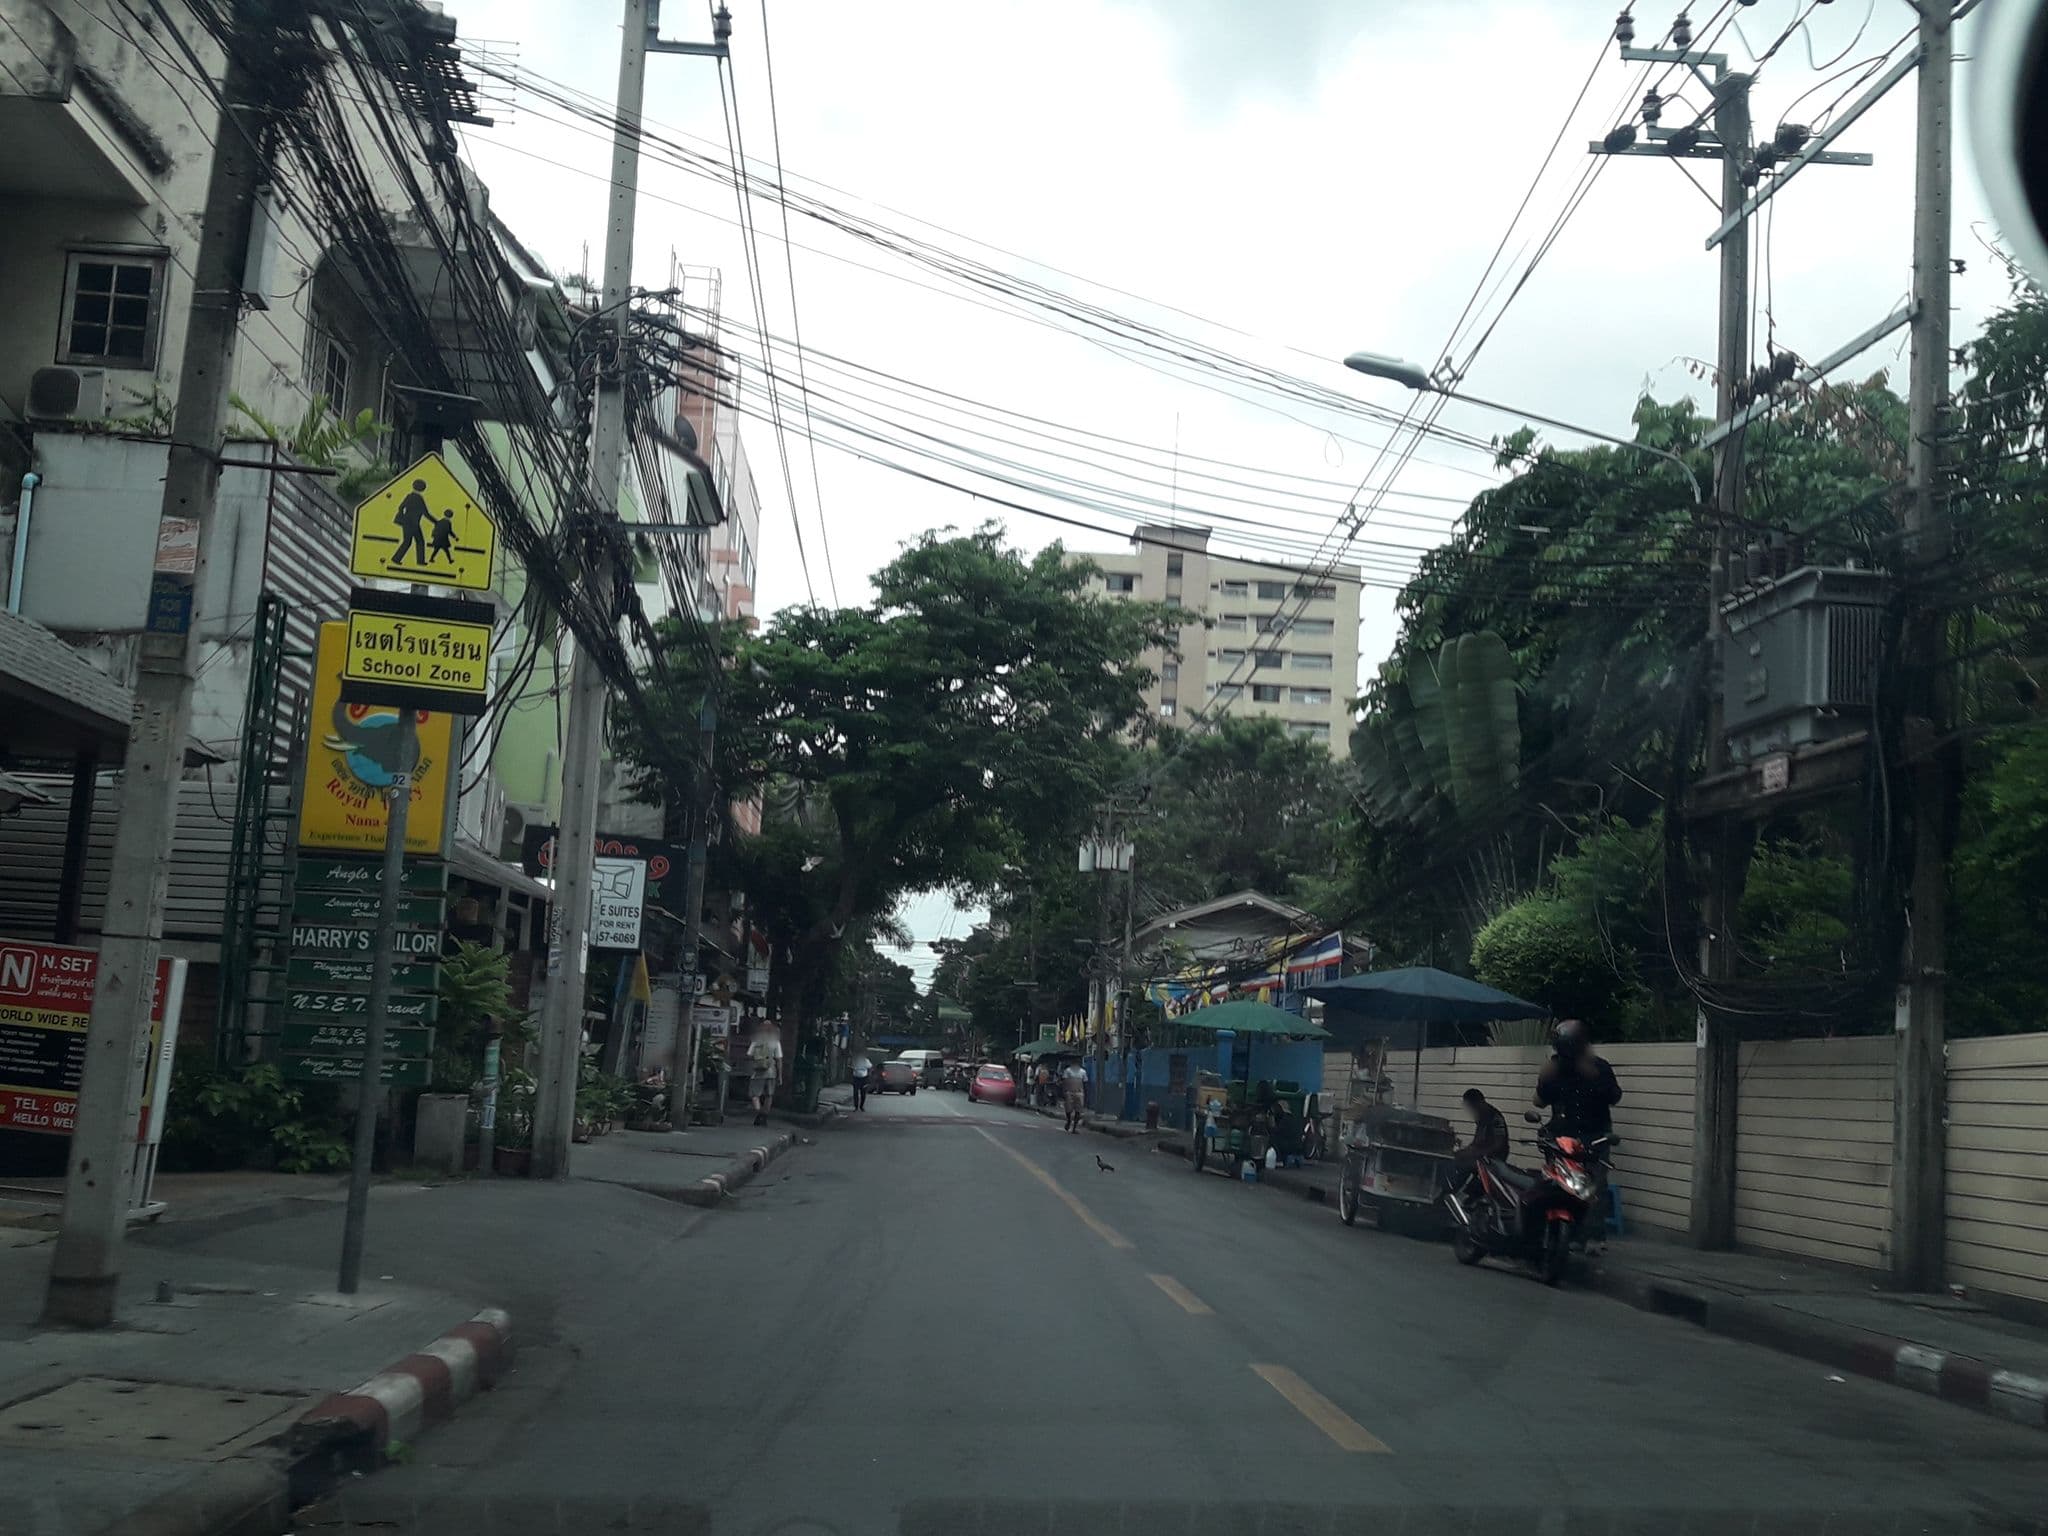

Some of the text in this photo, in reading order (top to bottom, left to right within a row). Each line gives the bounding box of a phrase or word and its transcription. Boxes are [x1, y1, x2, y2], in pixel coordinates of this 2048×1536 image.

[355, 623, 481, 661] เขตโรงเรียน
[362, 657, 471, 683] School Zone
[327, 778, 369, 809] Royal
[346, 813, 380, 827] Nana
[326, 864, 369, 883] Anglo
[649, 855, 670, 880] 9
[608, 904, 640, 919] SUITES
[599, 920, 636, 930] FOR RENT
[292, 927, 437, 953] HARRY'S ILOR
[1, 953, 32, 989] N
[0, 1008, 34, 1022] ORLD
[38, 1013, 68, 1026] WIDE
[384, 1002, 426, 1015] ravel
[14, 1096, 40, 1111] TEL
[12, 1113, 49, 1126] HELLO
